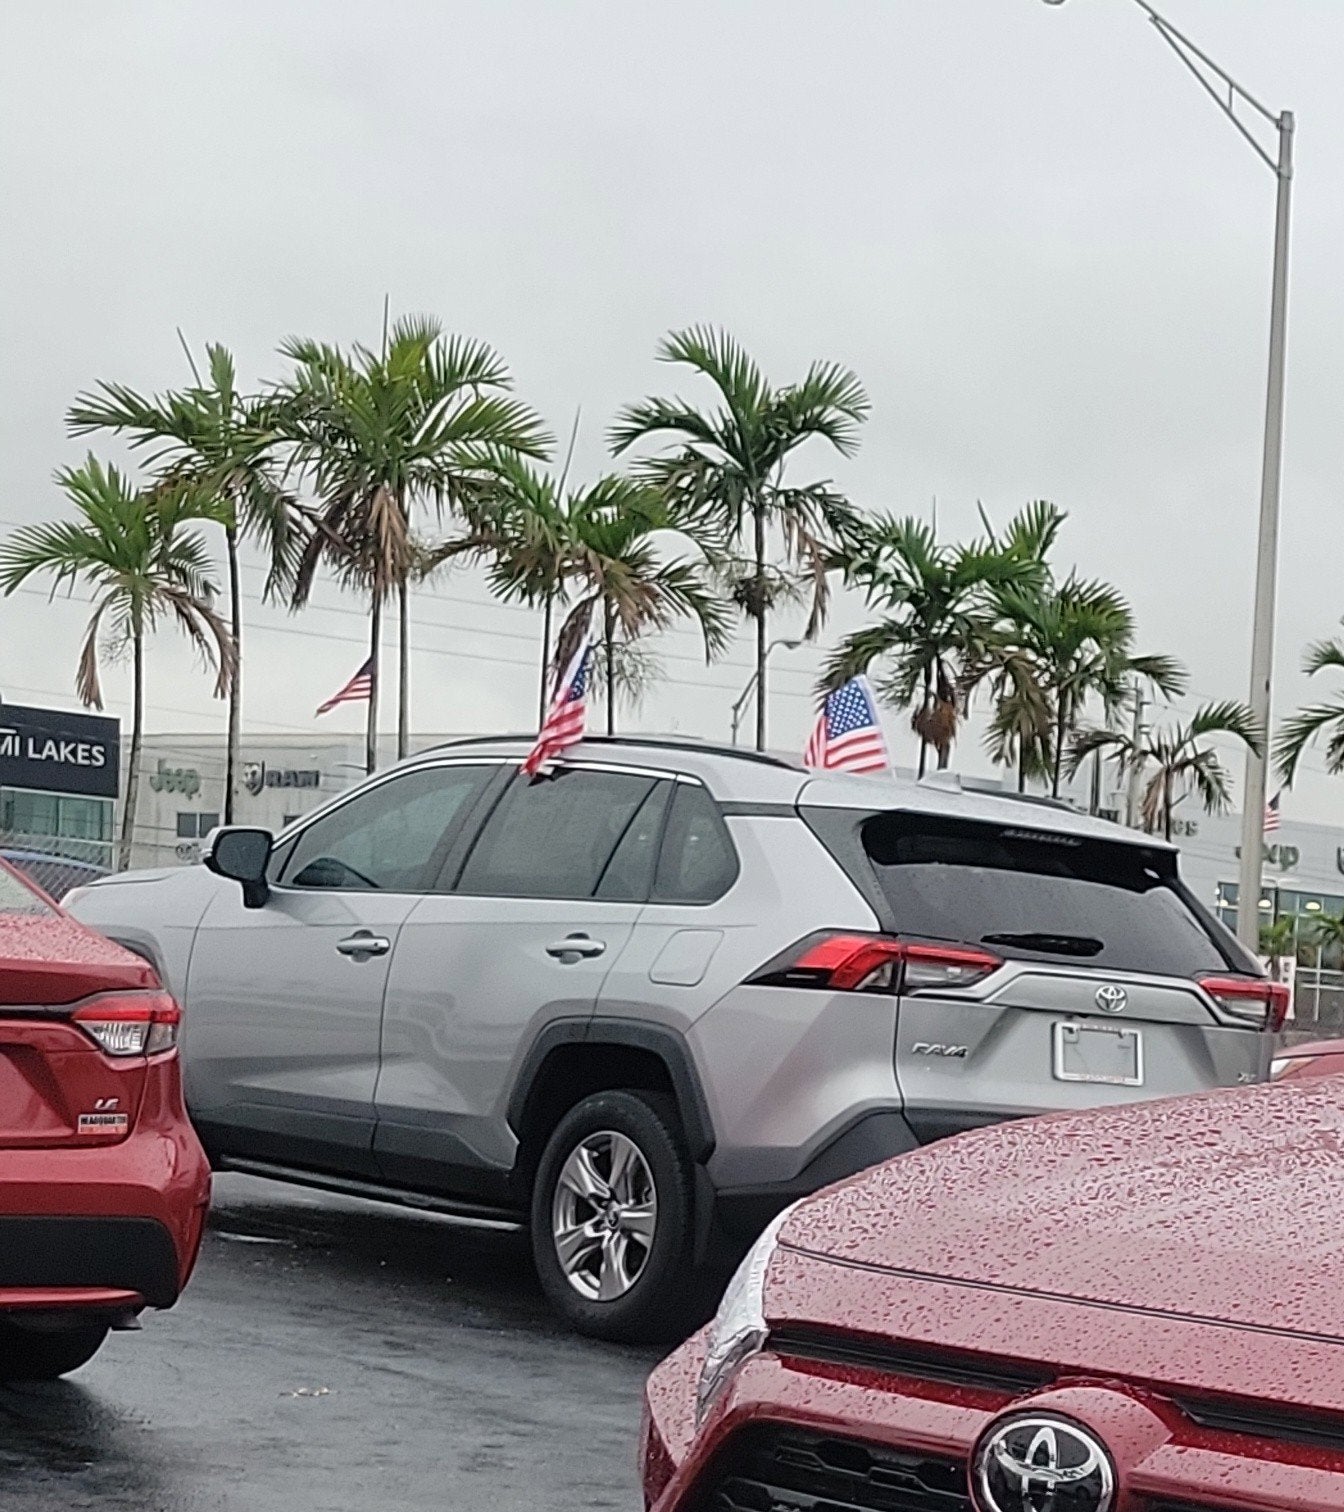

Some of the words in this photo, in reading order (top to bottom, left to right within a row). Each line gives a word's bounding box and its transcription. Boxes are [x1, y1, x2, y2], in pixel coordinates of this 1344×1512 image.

[27, 737, 105, 767] LAKES
[265, 770, 320, 788] RAM
[911, 1042, 968, 1058] RAV4
